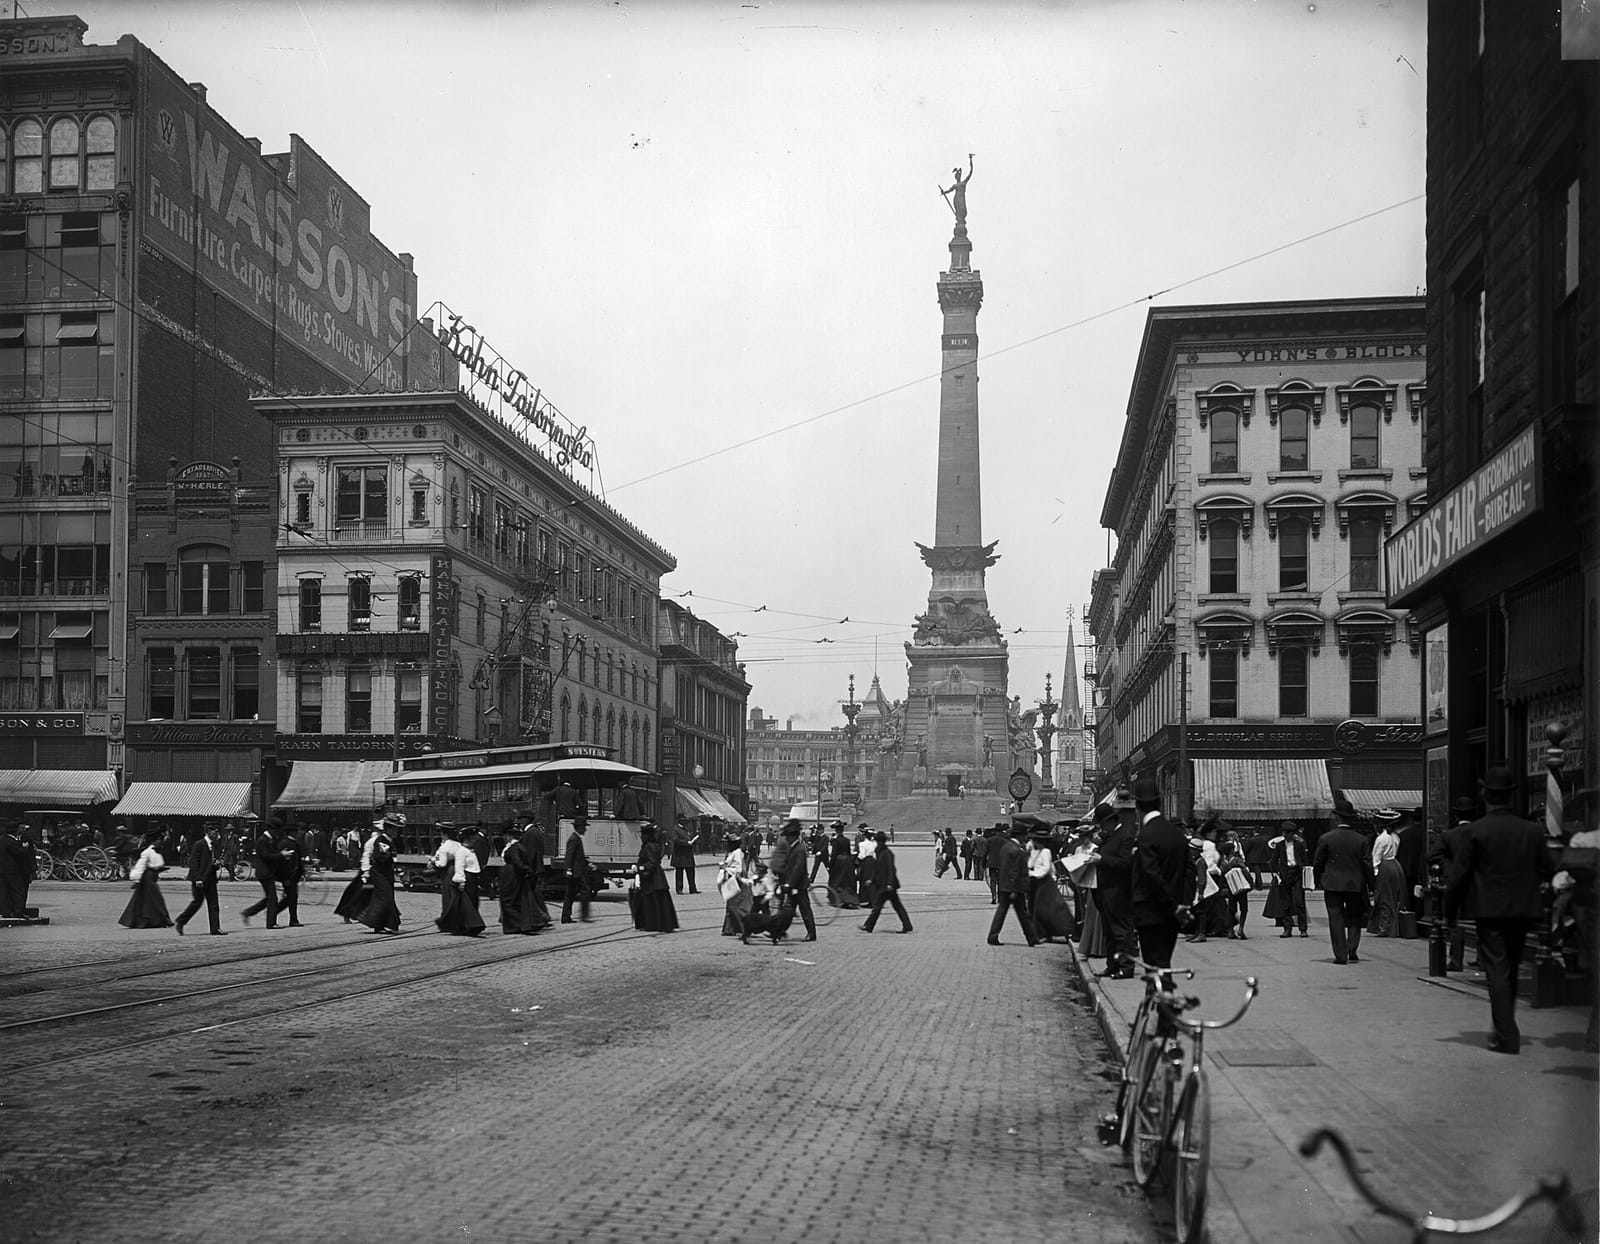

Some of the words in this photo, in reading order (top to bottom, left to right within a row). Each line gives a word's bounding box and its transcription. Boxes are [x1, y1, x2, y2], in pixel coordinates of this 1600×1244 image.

[184, 110, 411, 357] WASSON'S
[1237, 348, 1317, 362] YOHN'S
[1345, 343, 1425, 359] BLOCK
[441, 315, 499, 391] Kahn
[503, 370, 572, 466] Tailoring
[1478, 429, 1535, 503] INFORMATION
[1386, 507, 1441, 598] WORLD'S
[1445, 480, 1477, 560] FAIR
[436, 559, 450, 601] KAHN
[434, 606, 450, 701] TAILORING
[35, 719, 48, 728] &
[152, 725, 201, 743] William
[1207, 732, 1265, 743] DOUGLAS
[1269, 732, 1303, 742] SHOE
[279, 741, 321, 751] KAHN
[327, 741, 406, 751] TAILORING
